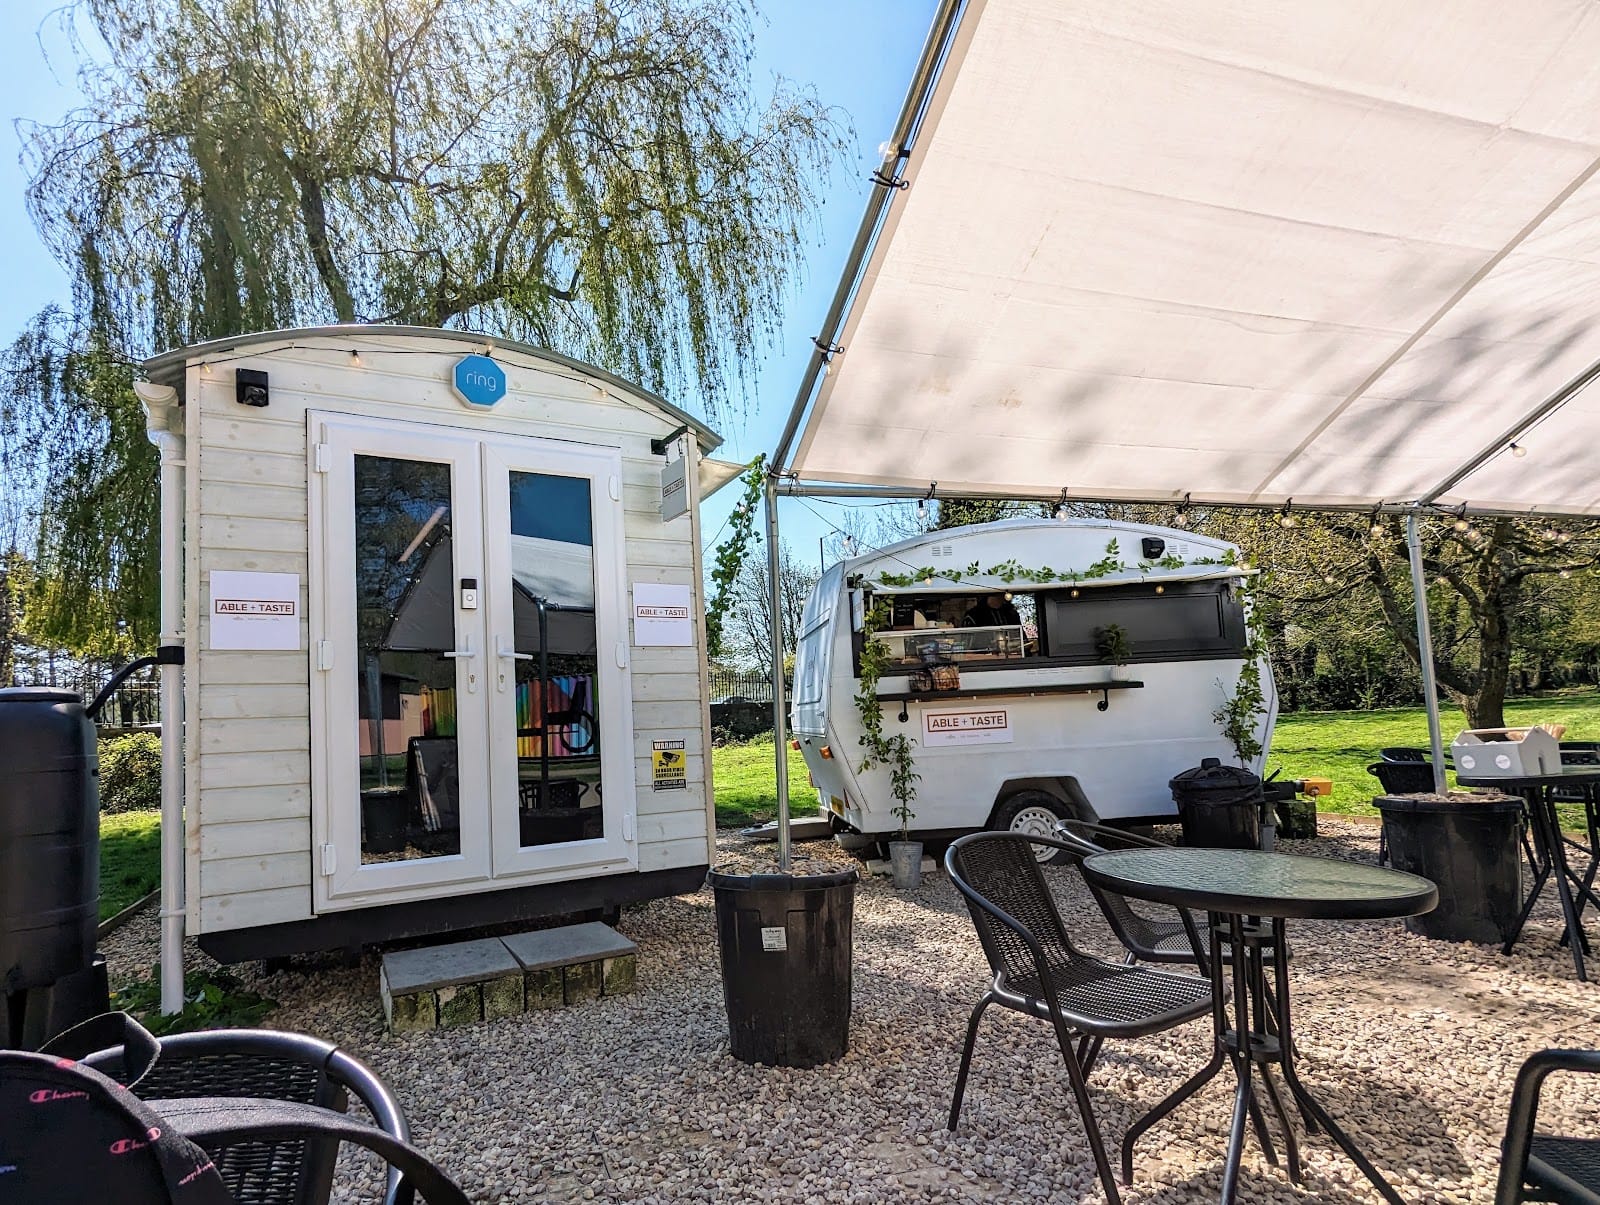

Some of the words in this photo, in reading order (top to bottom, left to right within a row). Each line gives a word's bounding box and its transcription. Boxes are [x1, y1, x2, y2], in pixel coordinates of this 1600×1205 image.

[466, 371, 496, 392] ring
[220, 603, 248, 611] ABLE
[259, 604, 292, 612] TASTE
[664, 609, 686, 617] TASTE
[932, 718, 960, 728] ABLE
[970, 715, 1004, 726] TASTE
[653, 741, 684, 750] WARNING
